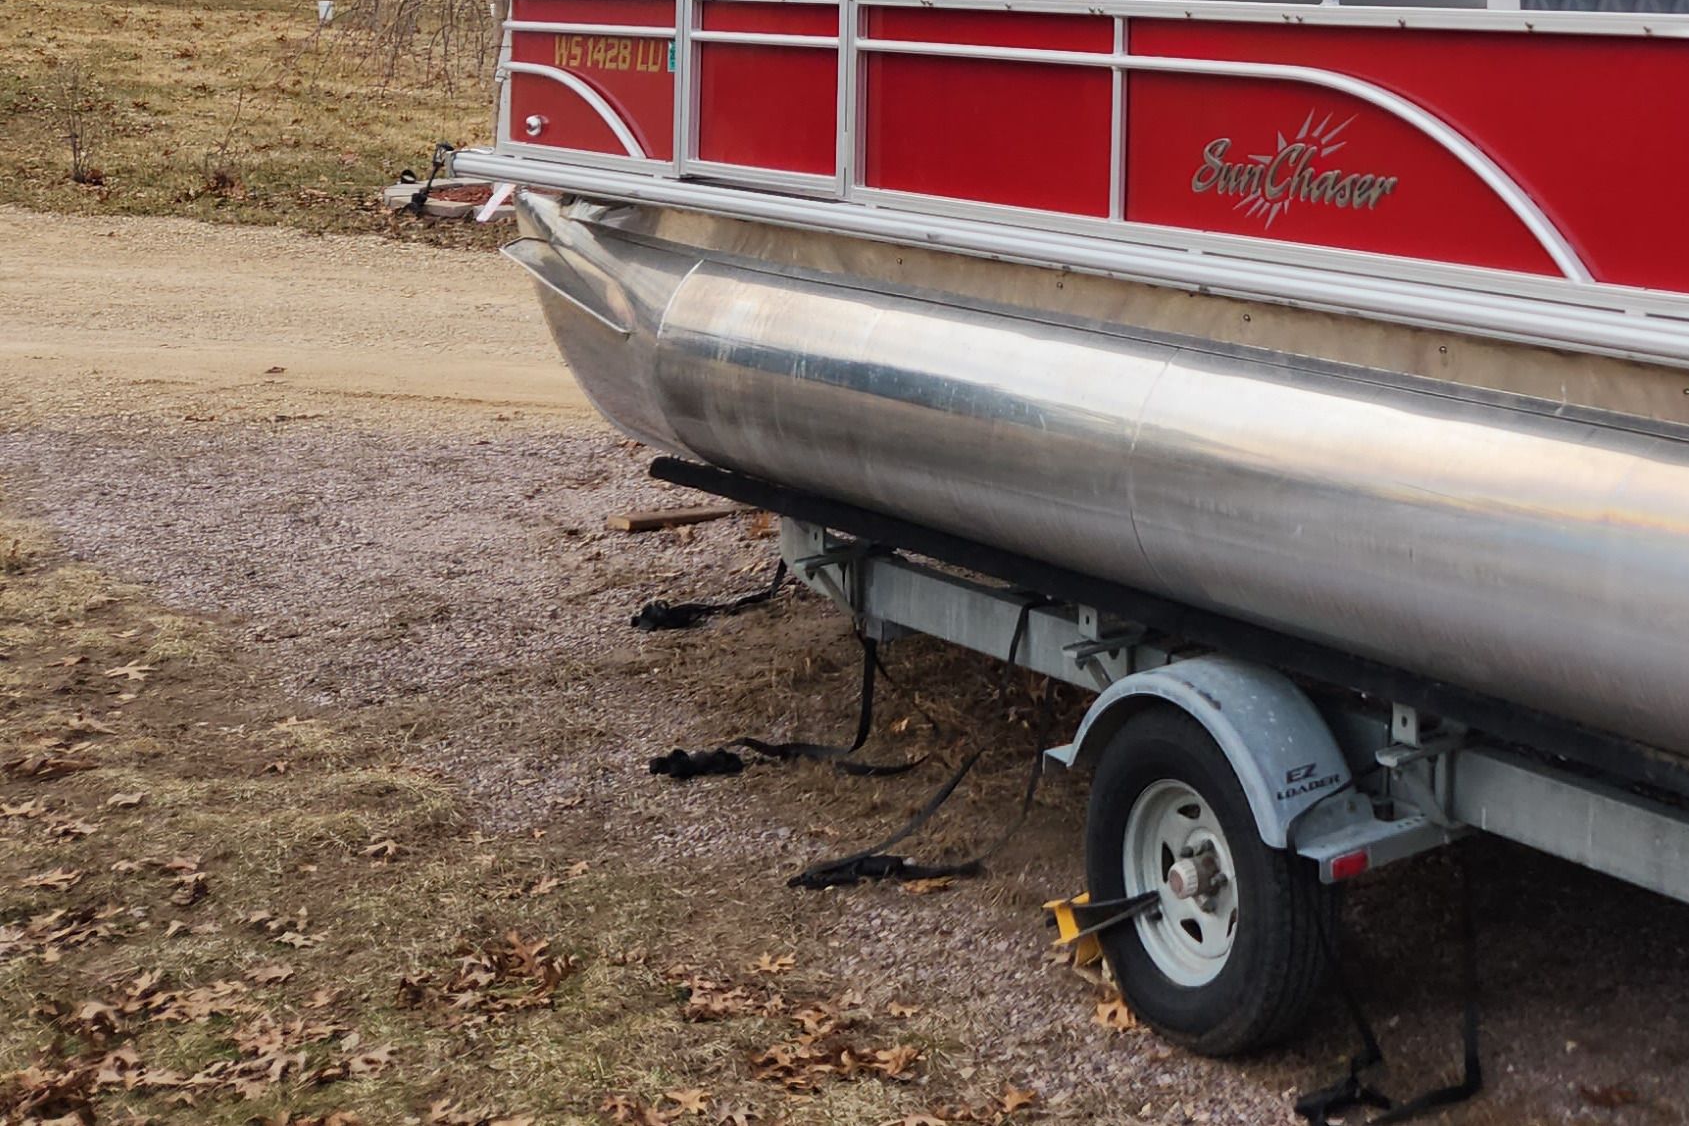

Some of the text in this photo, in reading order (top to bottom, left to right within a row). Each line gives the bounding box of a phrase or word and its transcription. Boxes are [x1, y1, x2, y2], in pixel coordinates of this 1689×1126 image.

[555, 35, 582, 67] WS
[587, 37, 632, 70] 1428
[636, 39, 663, 73] LU
[1286, 762, 1317, 784] EZ
[1276, 774, 1341, 801] LOADER
